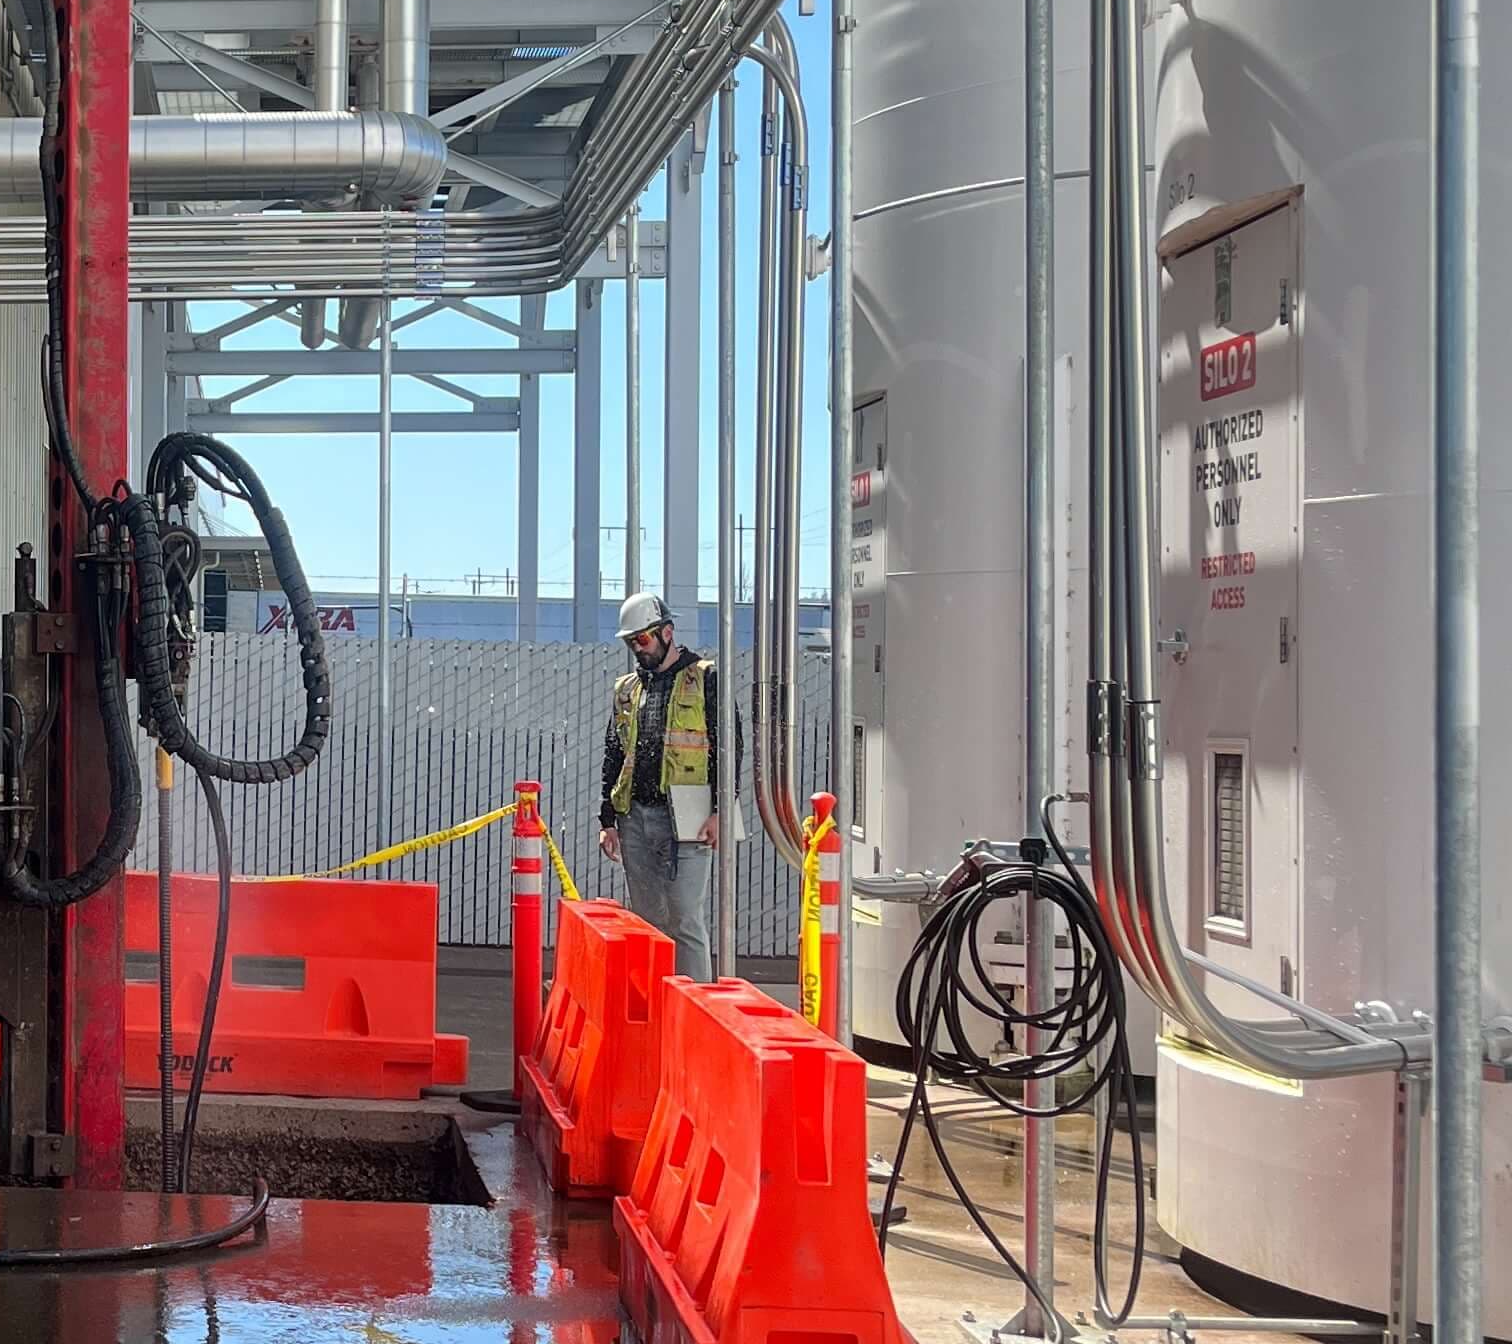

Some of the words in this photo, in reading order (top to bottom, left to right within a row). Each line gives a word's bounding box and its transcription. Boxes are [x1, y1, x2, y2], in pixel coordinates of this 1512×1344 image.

[1188, 173, 1196, 201] 2
[1203, 345, 1238, 394] SILO
[1242, 340, 1253, 388] 2
[1194, 409, 1264, 454] AUTHORIZED
[1196, 452, 1262, 492] PERSONNEL
[1214, 496, 1243, 528] ONLY
[1201, 552, 1257, 579] RESTRICTED
[1211, 587, 1246, 610] ACCESS
